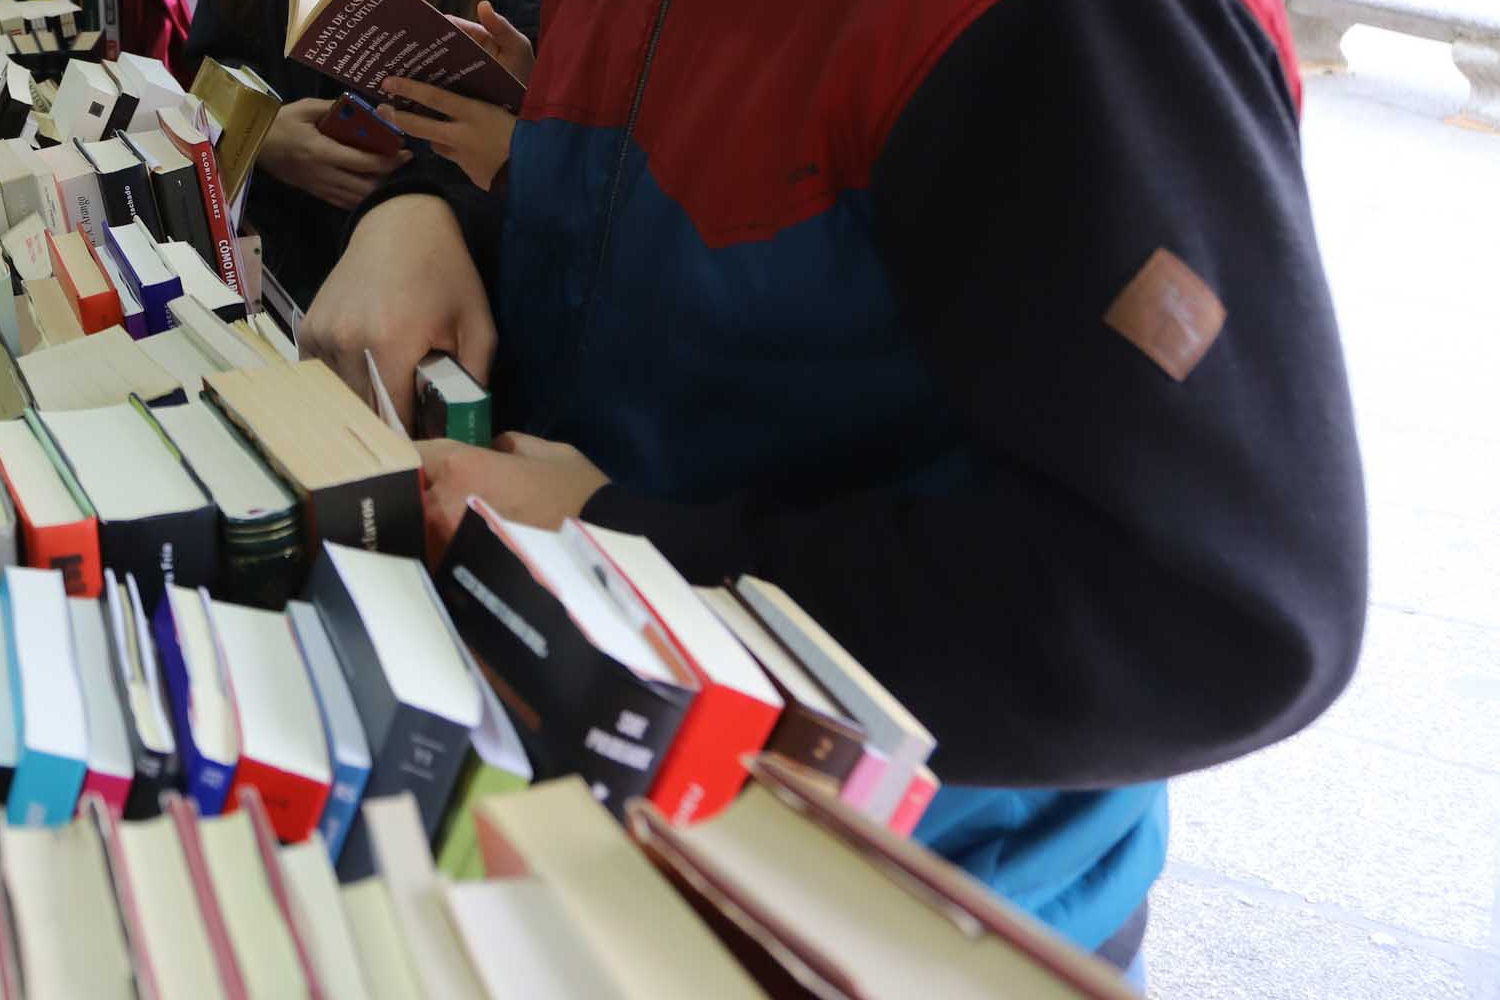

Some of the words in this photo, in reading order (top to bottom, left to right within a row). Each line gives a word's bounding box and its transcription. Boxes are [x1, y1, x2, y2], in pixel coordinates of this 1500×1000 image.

[304, 47, 319, 60] EL
[316, 22, 337, 47] AMA
[331, 9, 348, 26] DE
[316, 41, 338, 65] BAJO
[336, 27, 349, 41] EL
[332, 53, 352, 74] John
[348, 25, 379, 54] Harrison
[366, 69, 388, 89] Wally
[201, 151, 212, 186] GLORIA
[208, 182, 221, 220] ÁLVAREZ
[218, 240, 233, 270] CÓMO
